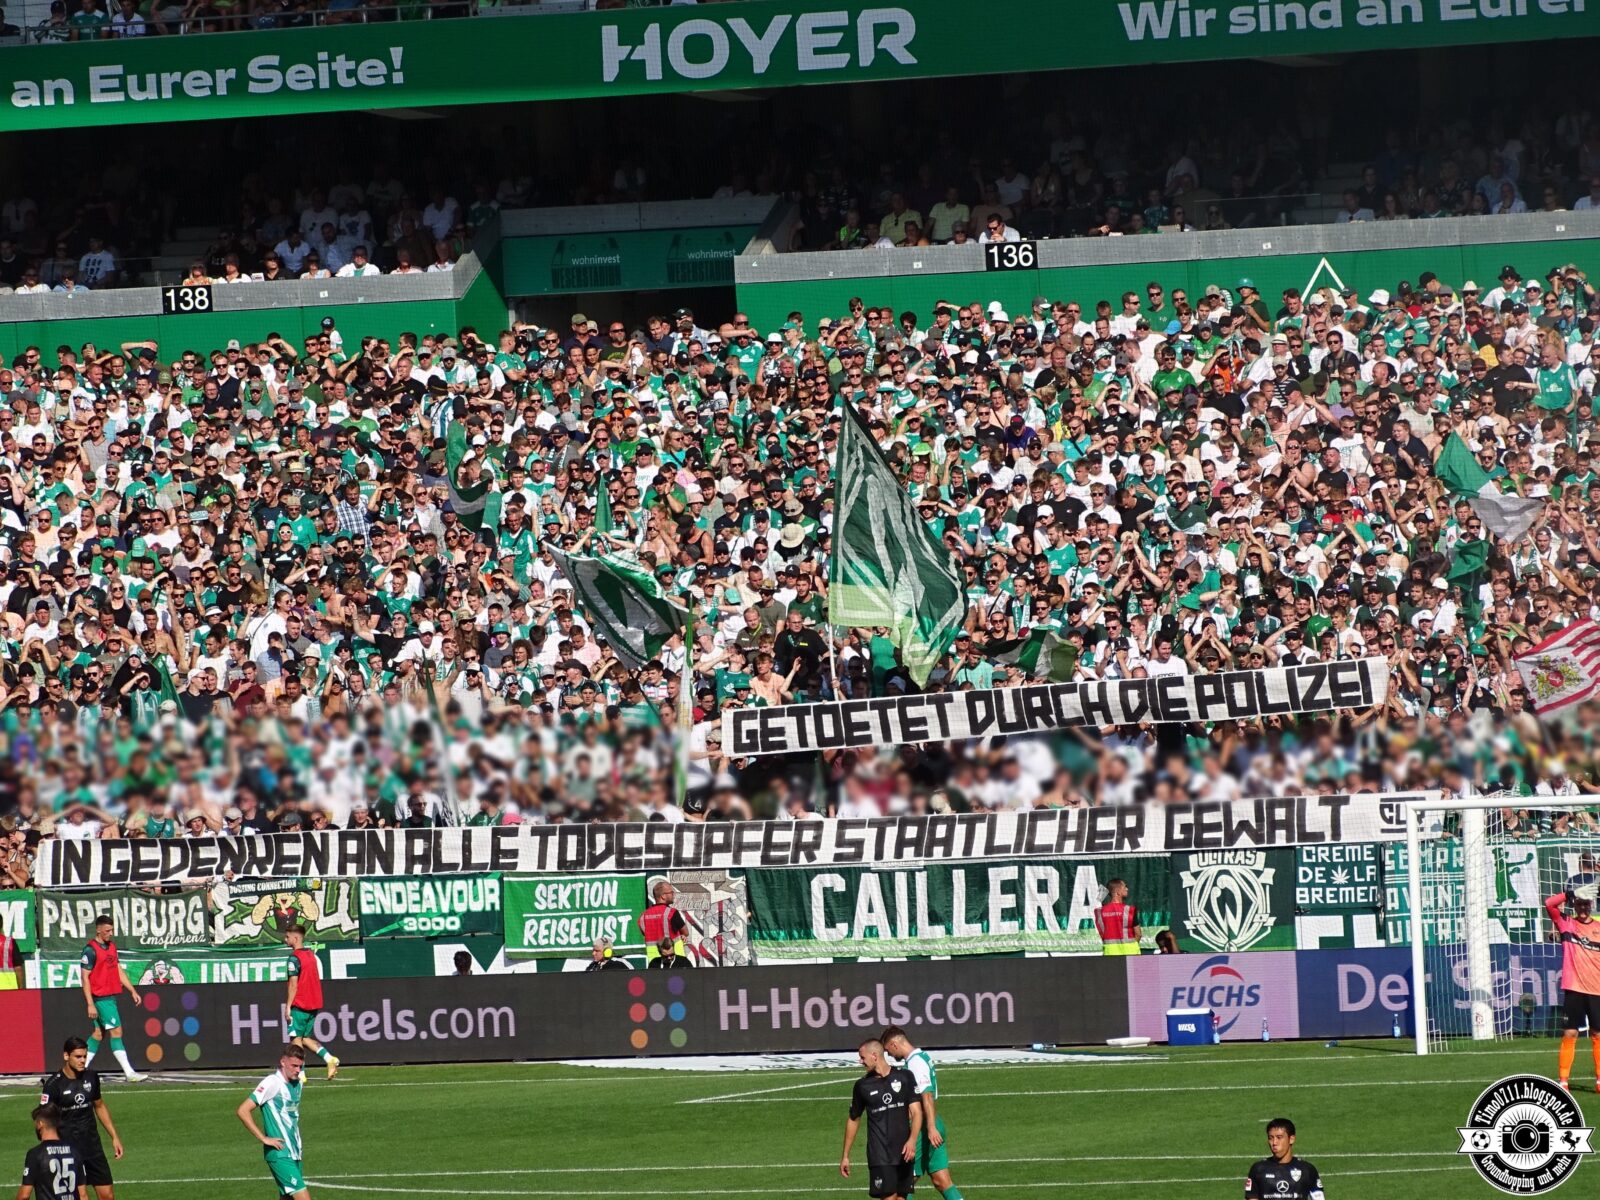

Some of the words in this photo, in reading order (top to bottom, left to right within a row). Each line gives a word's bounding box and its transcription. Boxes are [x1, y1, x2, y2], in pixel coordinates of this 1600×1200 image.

[1121, 0, 1216, 41] Wir
[1228, 0, 1342, 35] sind
[1356, 0, 1428, 26] an
[602, 7, 918, 82] HOYER
[10, 75, 75, 108] an
[89, 64, 236, 103] Eurer
[247, 46, 405, 94] Seite!
[572, 254, 621, 265] wohninvest
[687, 249, 737, 260] wohninvest
[987, 244, 1035, 268] 136
[164, 287, 210, 311] 138
[733, 694, 954, 753] GETOETET
[965, 681, 1114, 736] DURCH
[1118, 676, 1191, 723] DIE
[1194, 660, 1373, 720] POLIZEI
[51, 839, 91, 885] IN
[100, 832, 329, 882] GEDENKEN
[337, 830, 395, 875] AN
[404, 826, 520, 874] ALLE
[530, 820, 824, 871] TODESOPFER
[833, 805, 1146, 862] STAATLICHER
[1164, 795, 1350, 849] GEWALT
[1302, 845, 1375, 863] CREME
[1198, 850, 1258, 867] ULTRAS
[1385, 847, 1465, 870] SEMPR
[1298, 866, 1327, 884] DE
[1354, 865, 1377, 882] LA
[360, 879, 500, 914] ENDEAVOUR
[534, 880, 618, 910] SEKTION
[810, 866, 1102, 942] CAILLERA
[1296, 886, 1378, 904] BREMEN
[42, 895, 205, 939] PAPENBURG
[403, 917, 461, 932] 3000
[523, 914, 632, 946] REISELUST
[140, 931, 206, 949] Emsflorenz
[1170, 984, 1261, 1008] FUCHS
[1337, 964, 1432, 1012] De
[719, 983, 1014, 1031] H-Hotels.com
[49, 1157, 76, 1195] 25
